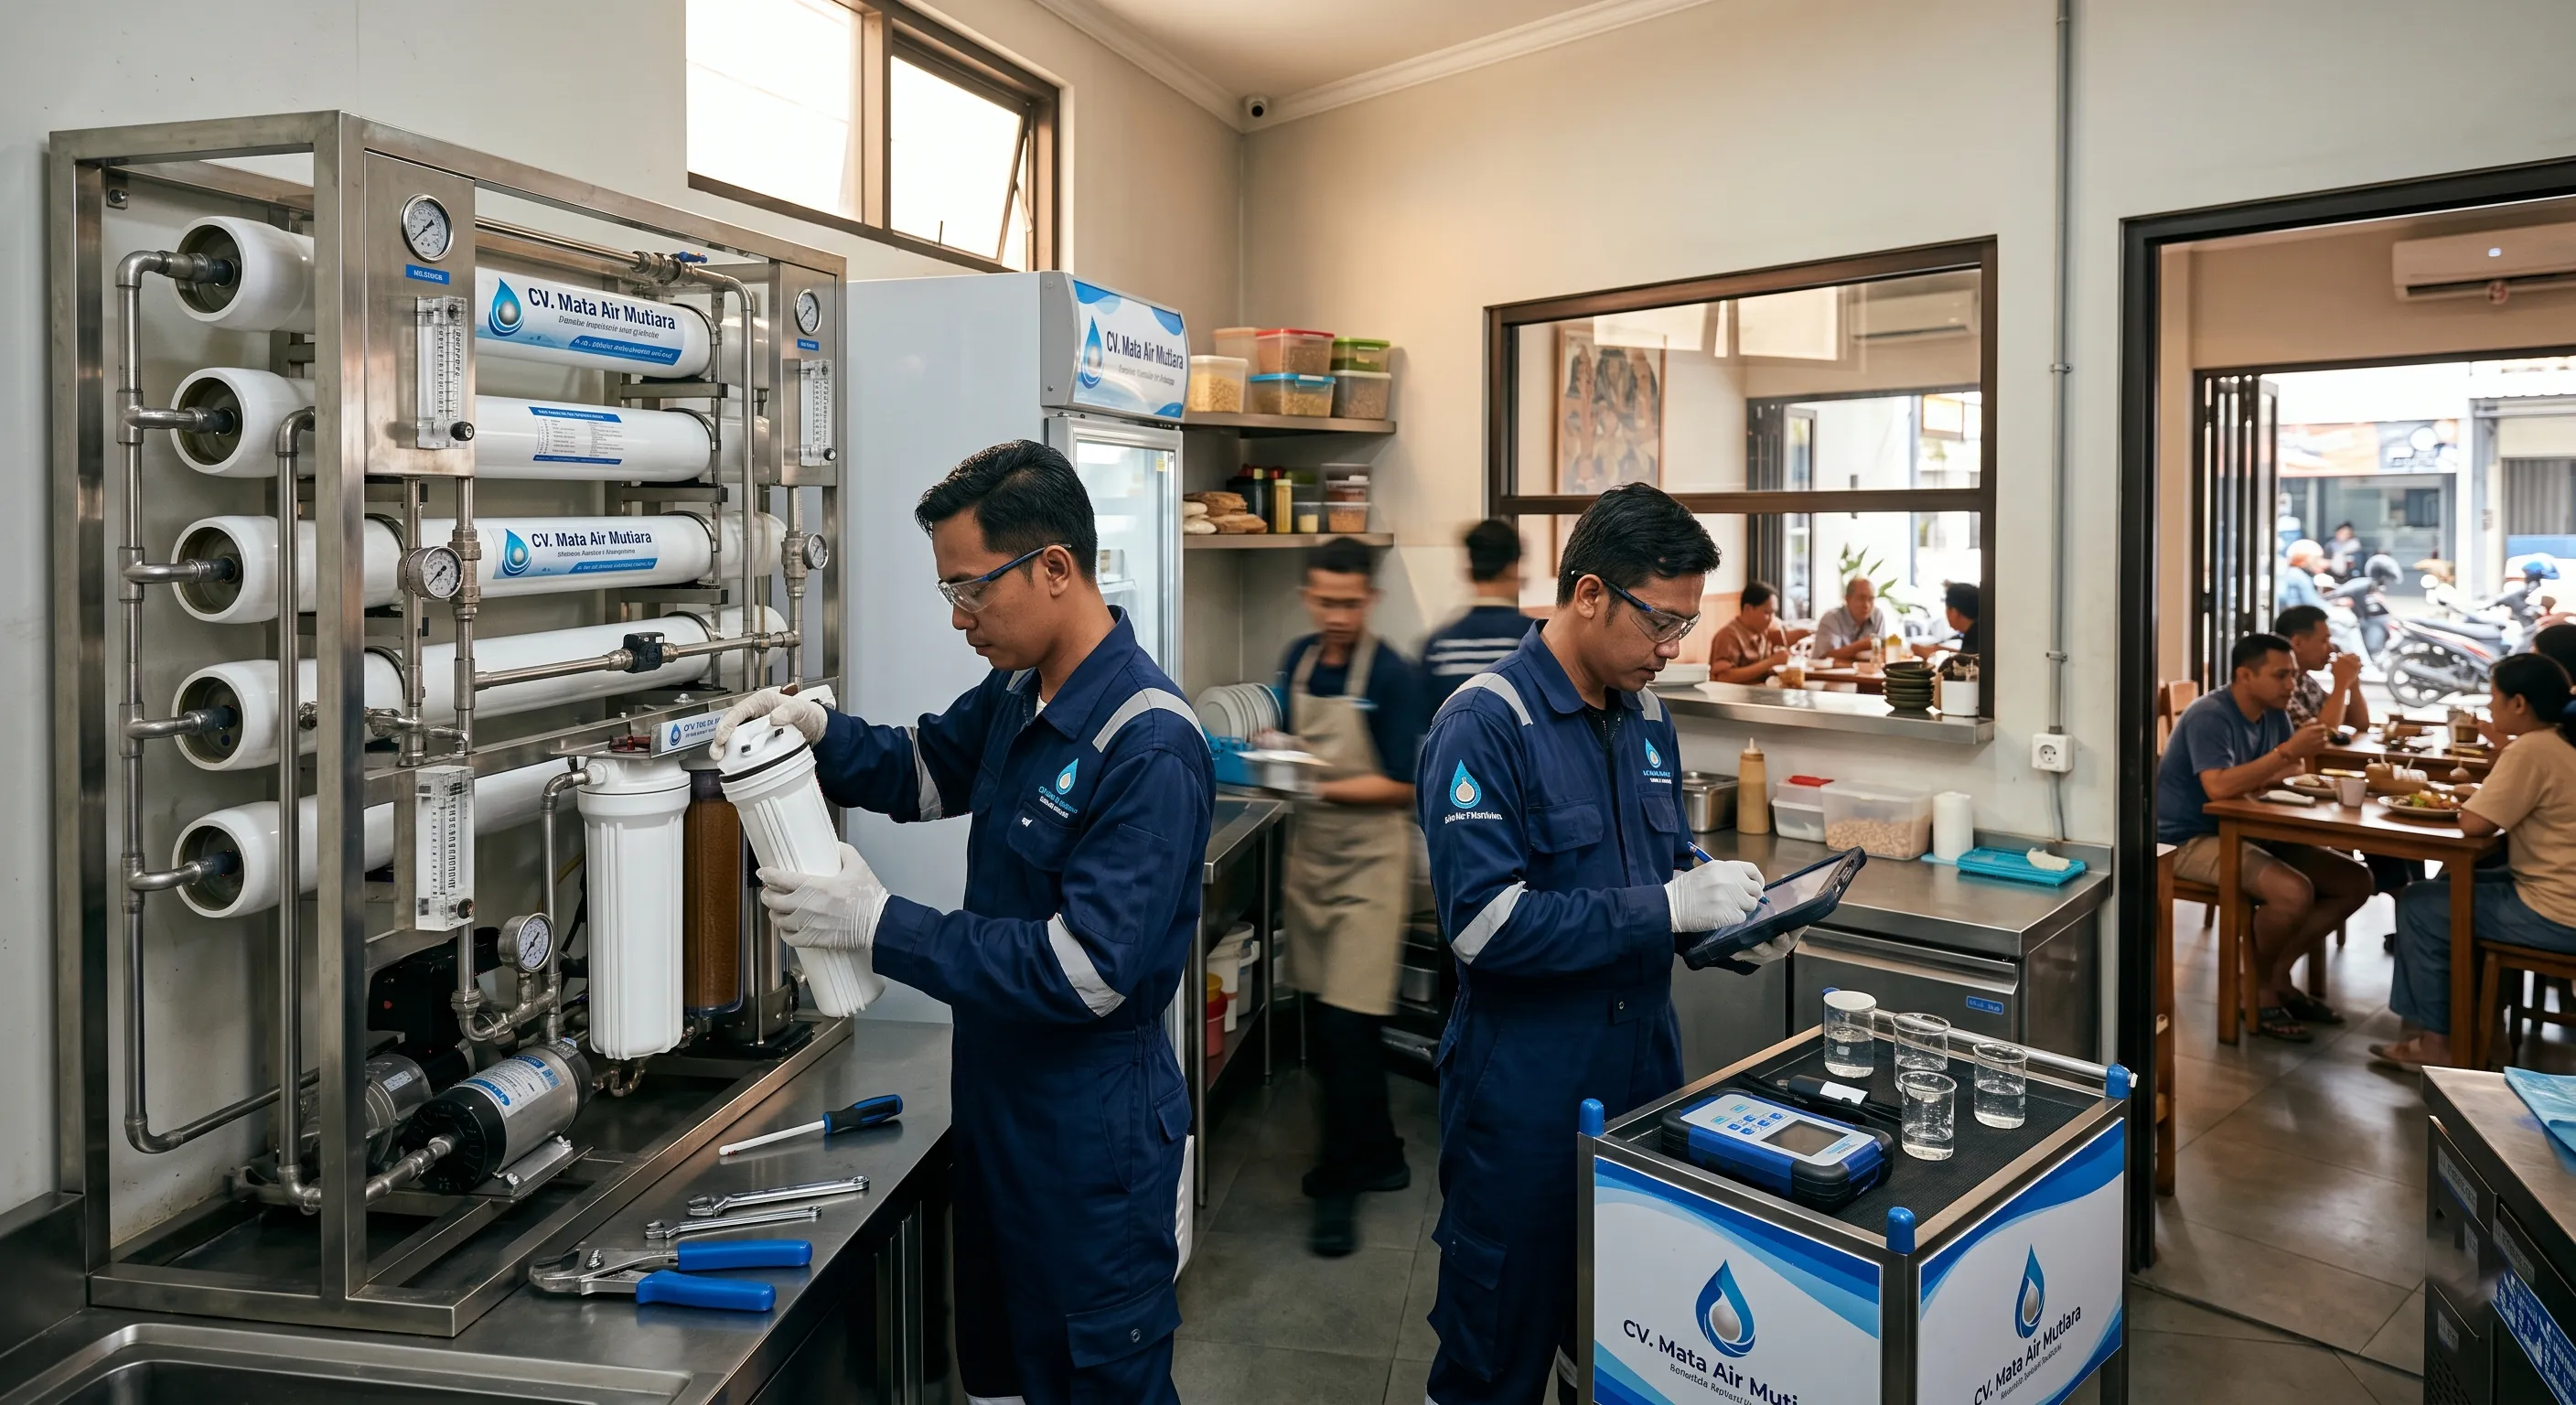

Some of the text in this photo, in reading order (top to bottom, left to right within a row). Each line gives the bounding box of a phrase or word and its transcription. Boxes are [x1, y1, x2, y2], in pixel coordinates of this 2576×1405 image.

[528, 287, 676, 330] CV. Mata Air Mutiara
[1106, 330, 1184, 370] CV. Mata Air Mutiara
[531, 531, 652, 548] CV. Mata Air Mutiara
[1623, 1319, 1654, 1347] CV.
[1658, 1335, 1707, 1373] Mata
[1712, 1362, 1744, 1389] Air
[1974, 1379, 1993, 1405] CV.
[1996, 1357, 2023, 1391] Mata
[2025, 1338, 2041, 1367] Air
